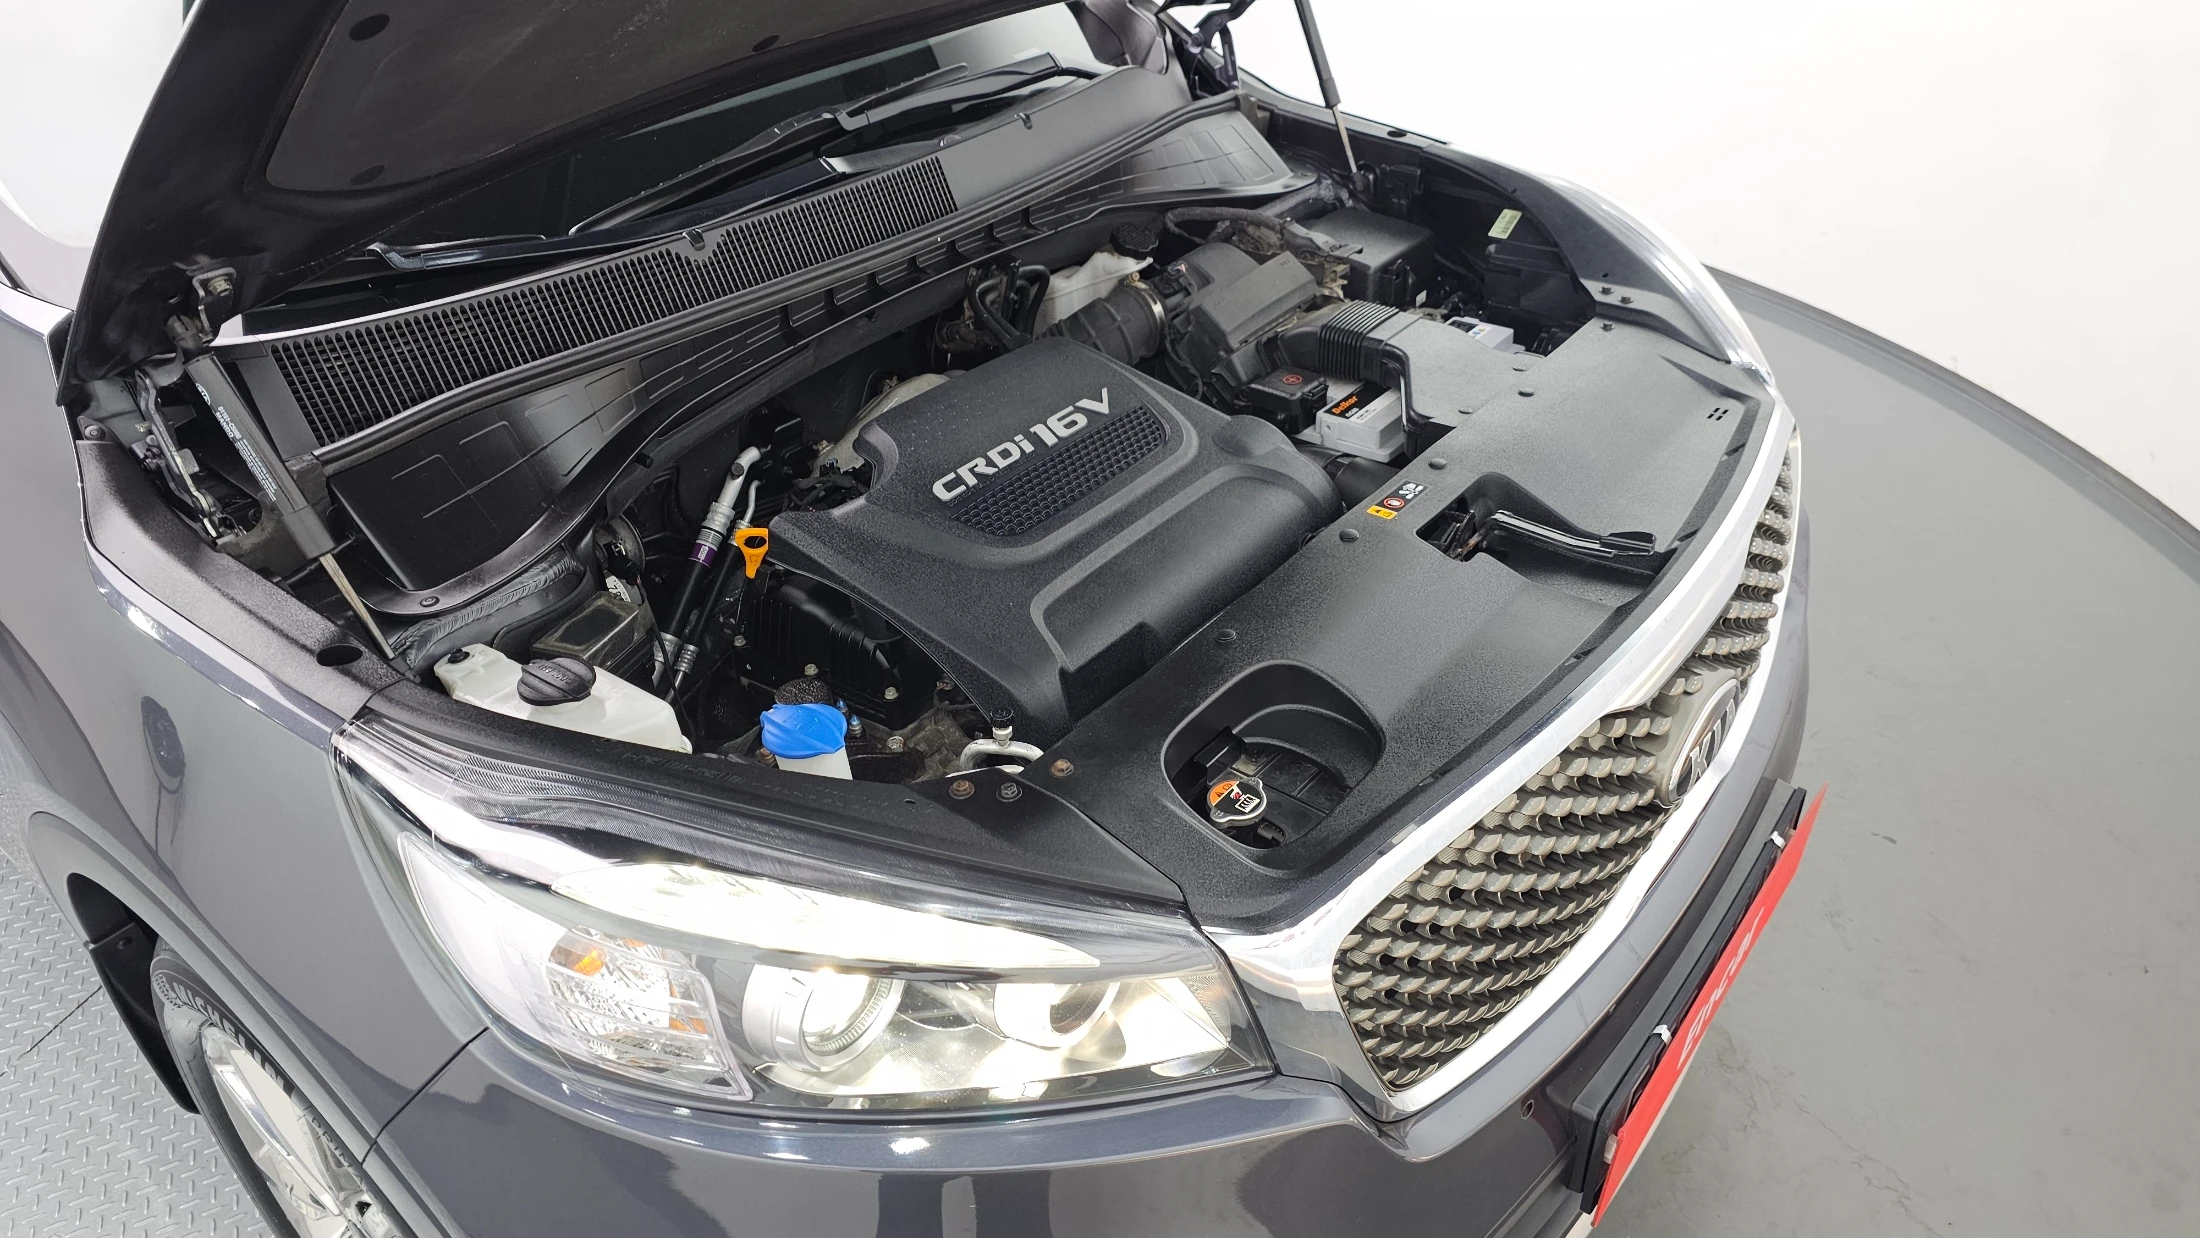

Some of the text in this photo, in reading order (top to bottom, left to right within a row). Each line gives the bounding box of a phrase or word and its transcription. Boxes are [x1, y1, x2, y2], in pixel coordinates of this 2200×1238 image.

[932, 386, 1110, 502] CRDi 16V
[1331, 395, 1359, 415] Delkor
[172, 981, 285, 1092] MICHELIN
